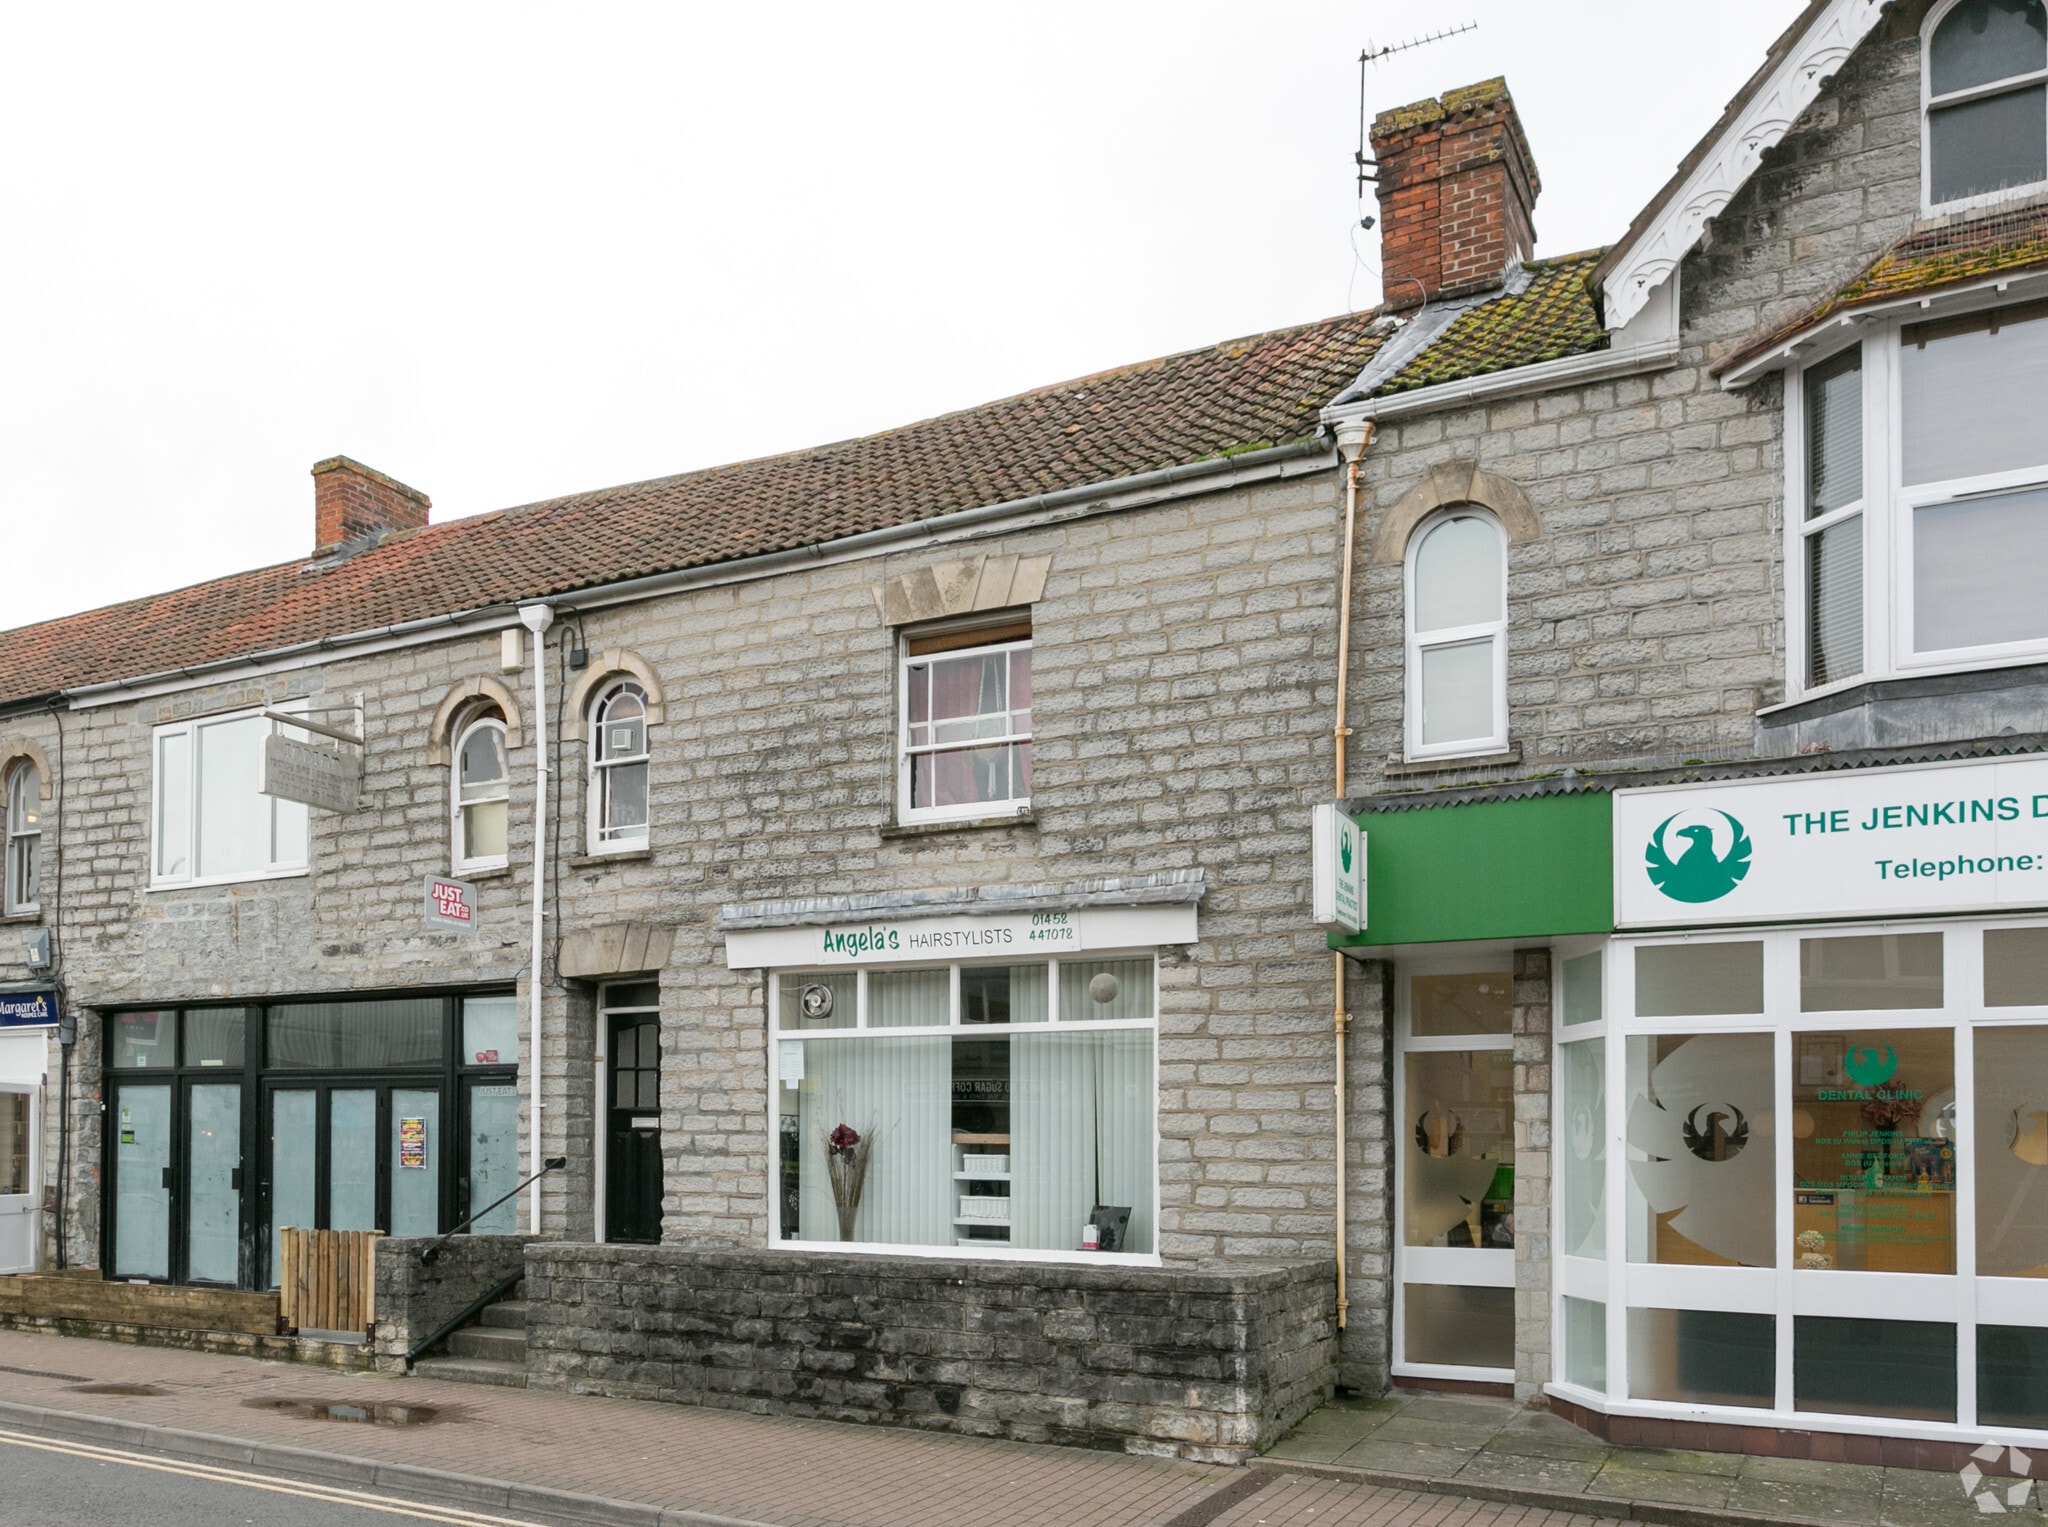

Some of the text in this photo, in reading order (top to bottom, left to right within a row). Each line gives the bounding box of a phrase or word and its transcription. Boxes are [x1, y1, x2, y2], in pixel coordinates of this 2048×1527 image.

[1783, 810, 1850, 836] THE
[1861, 796, 2020, 831] JENKINS
[1875, 854, 2043, 881] Telephone:
[432, 883, 462, 903] JUST
[1032, 912, 1068, 926] 01458
[823, 926, 1013, 957] Angela's HAIRSTYLISTS
[1029, 928, 1073, 942] 447078
[1818, 1089, 1923, 1101] DENTAL CLINIC
